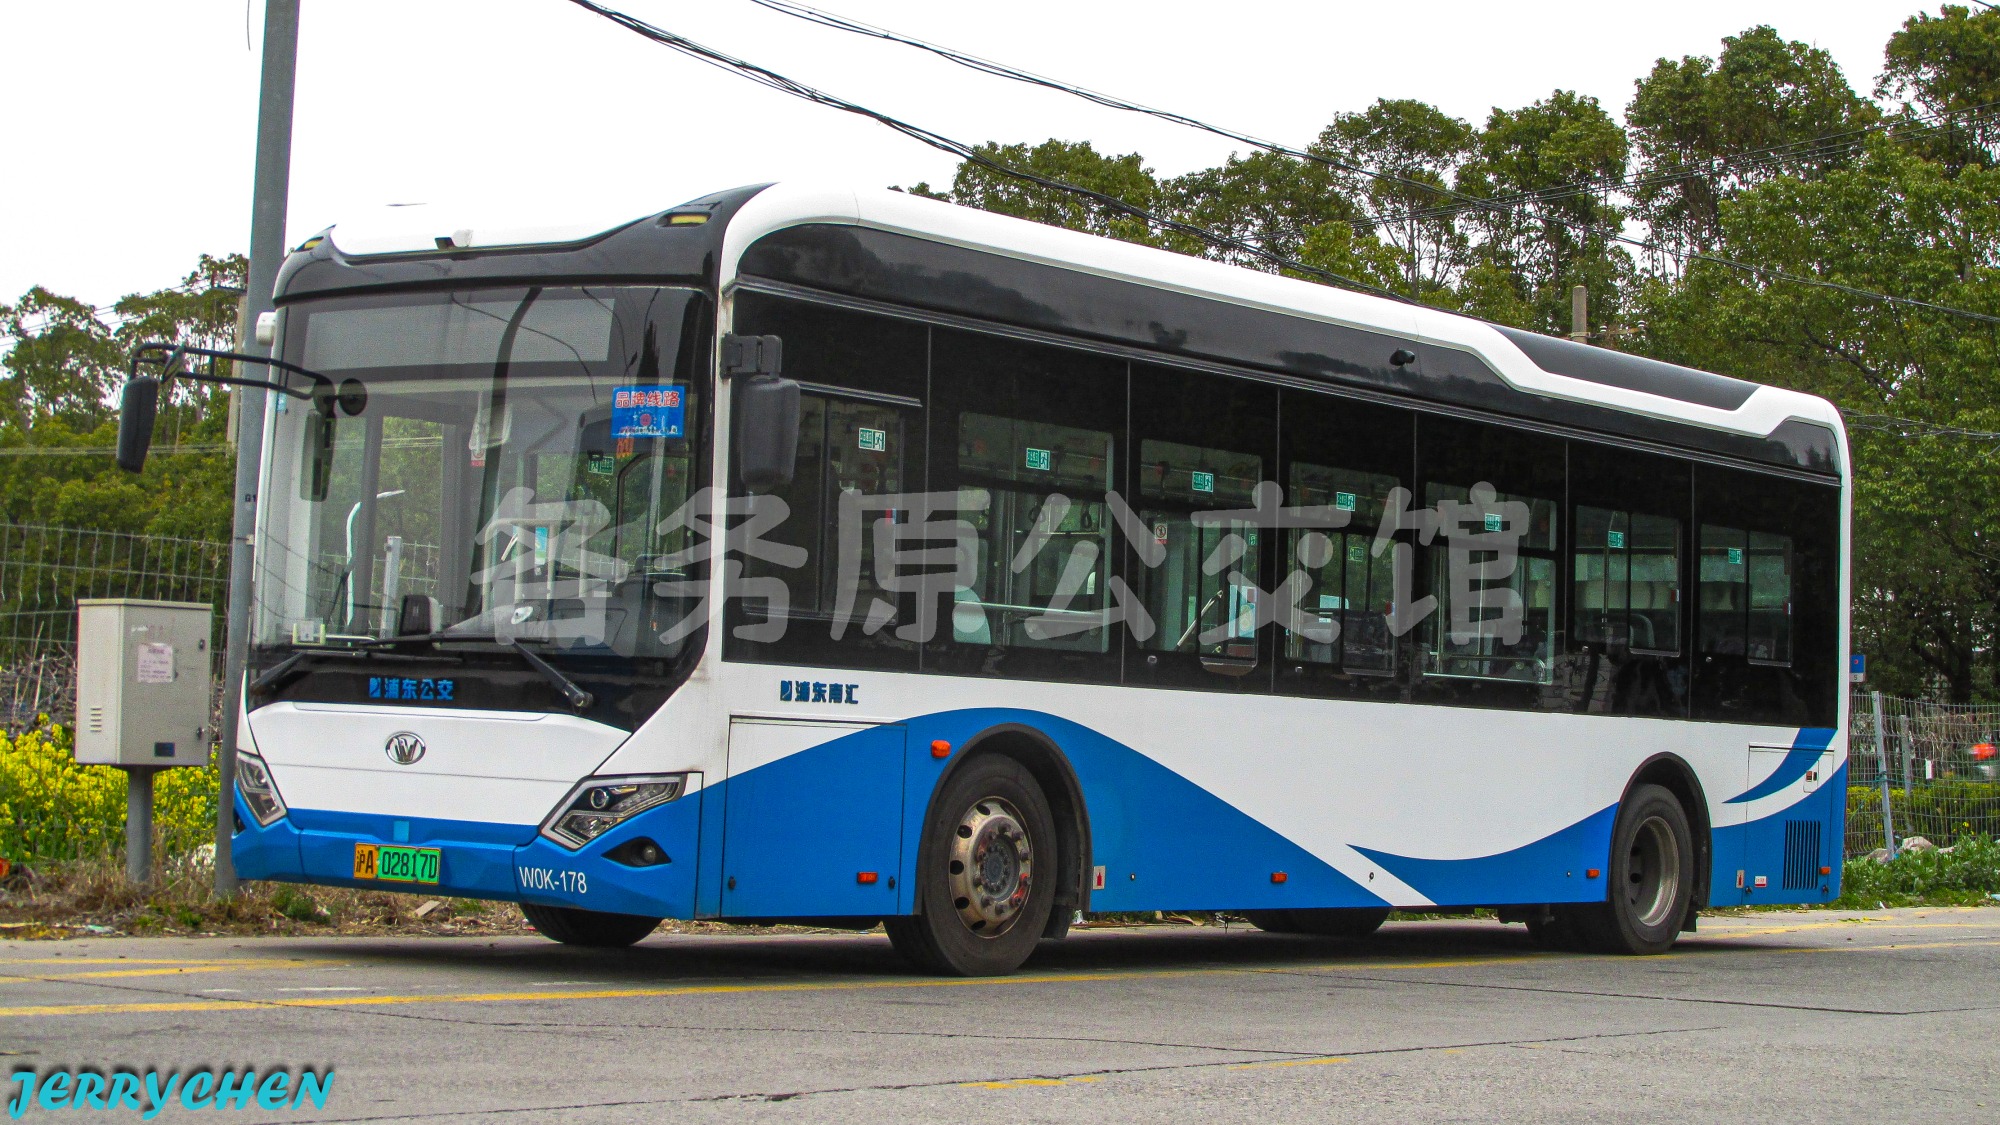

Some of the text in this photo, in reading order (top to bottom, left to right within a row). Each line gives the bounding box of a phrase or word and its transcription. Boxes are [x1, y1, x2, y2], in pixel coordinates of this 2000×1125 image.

[615, 390, 680, 409] 品牌线路
[384, 678, 454, 700] 浦东公交
[795, 681, 859, 704] 浦东南汇
